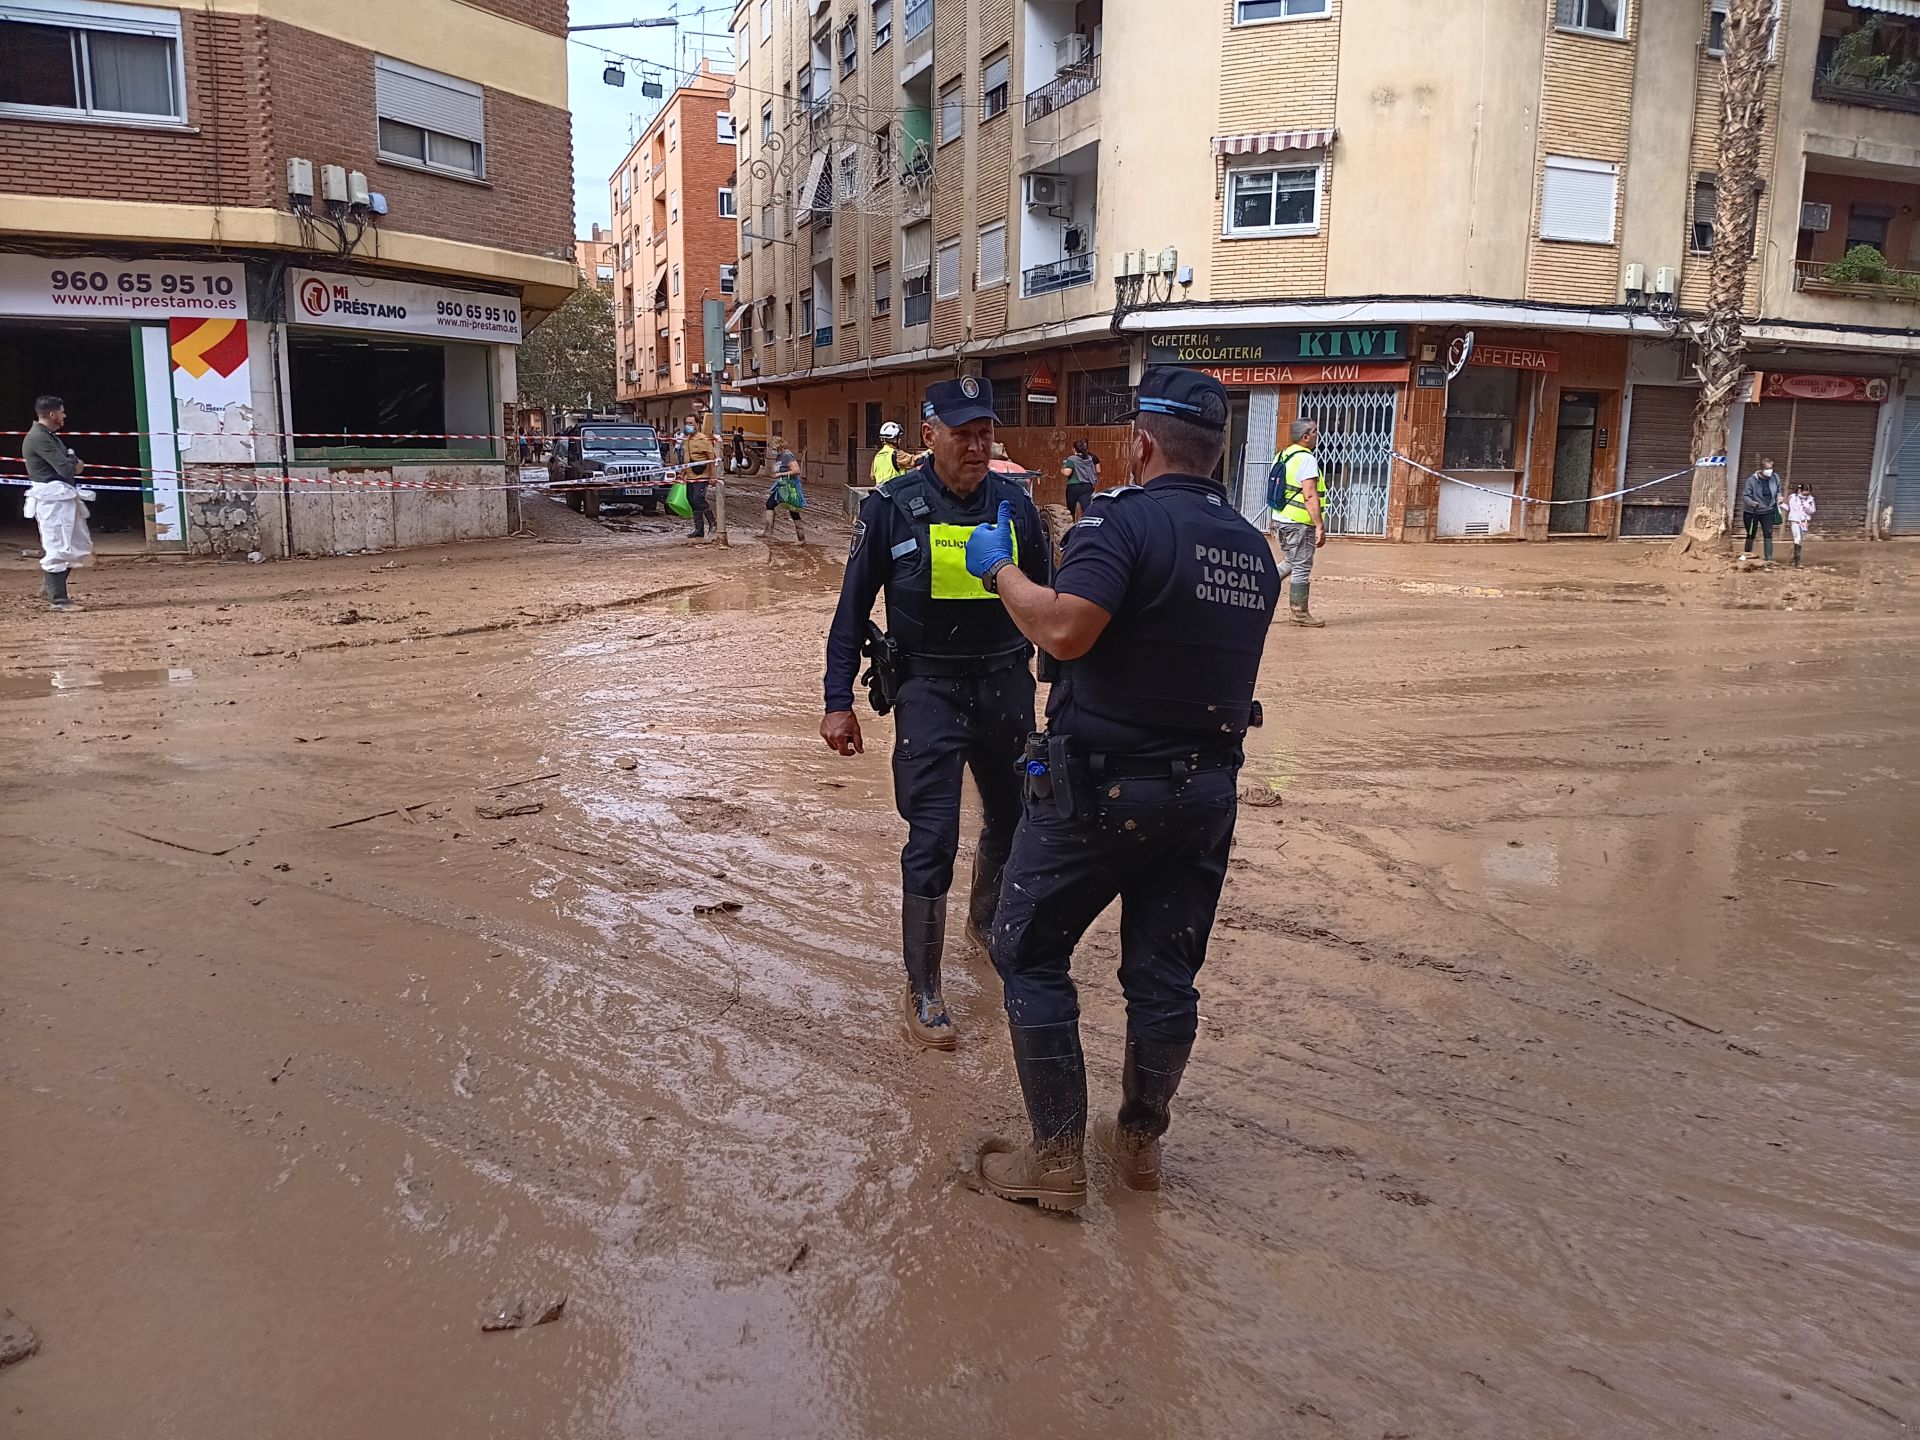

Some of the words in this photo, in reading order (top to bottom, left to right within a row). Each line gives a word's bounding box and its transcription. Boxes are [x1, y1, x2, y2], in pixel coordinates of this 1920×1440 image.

[51, 270, 109, 292] 960
[117, 272, 152, 293] 65
[160, 274, 195, 295] 95
[202, 276, 233, 296] 10
[52, 293, 237, 310] www.mi-prestamo.es
[334, 299, 407, 320] PRÉSTAMO
[436, 300, 463, 317] 960
[465, 304, 482, 320] 65
[485, 306, 501, 322] 95
[502, 308, 517, 323] 10
[437, 317, 518, 334] www.mi-prestamo.es
[1151, 333, 1209, 347] CAFETERIA
[1298, 329, 1399, 357] KIWI
[1177, 346, 1262, 361] XOCOLATERIA
[1469, 346, 1546, 368] AFETERIA
[1321, 365, 1360, 381] KIWI
[1195, 544, 1265, 573] POLICIA
[1204, 565, 1260, 592] LOCAL
[1196, 584, 1266, 611] OLIVENZA
